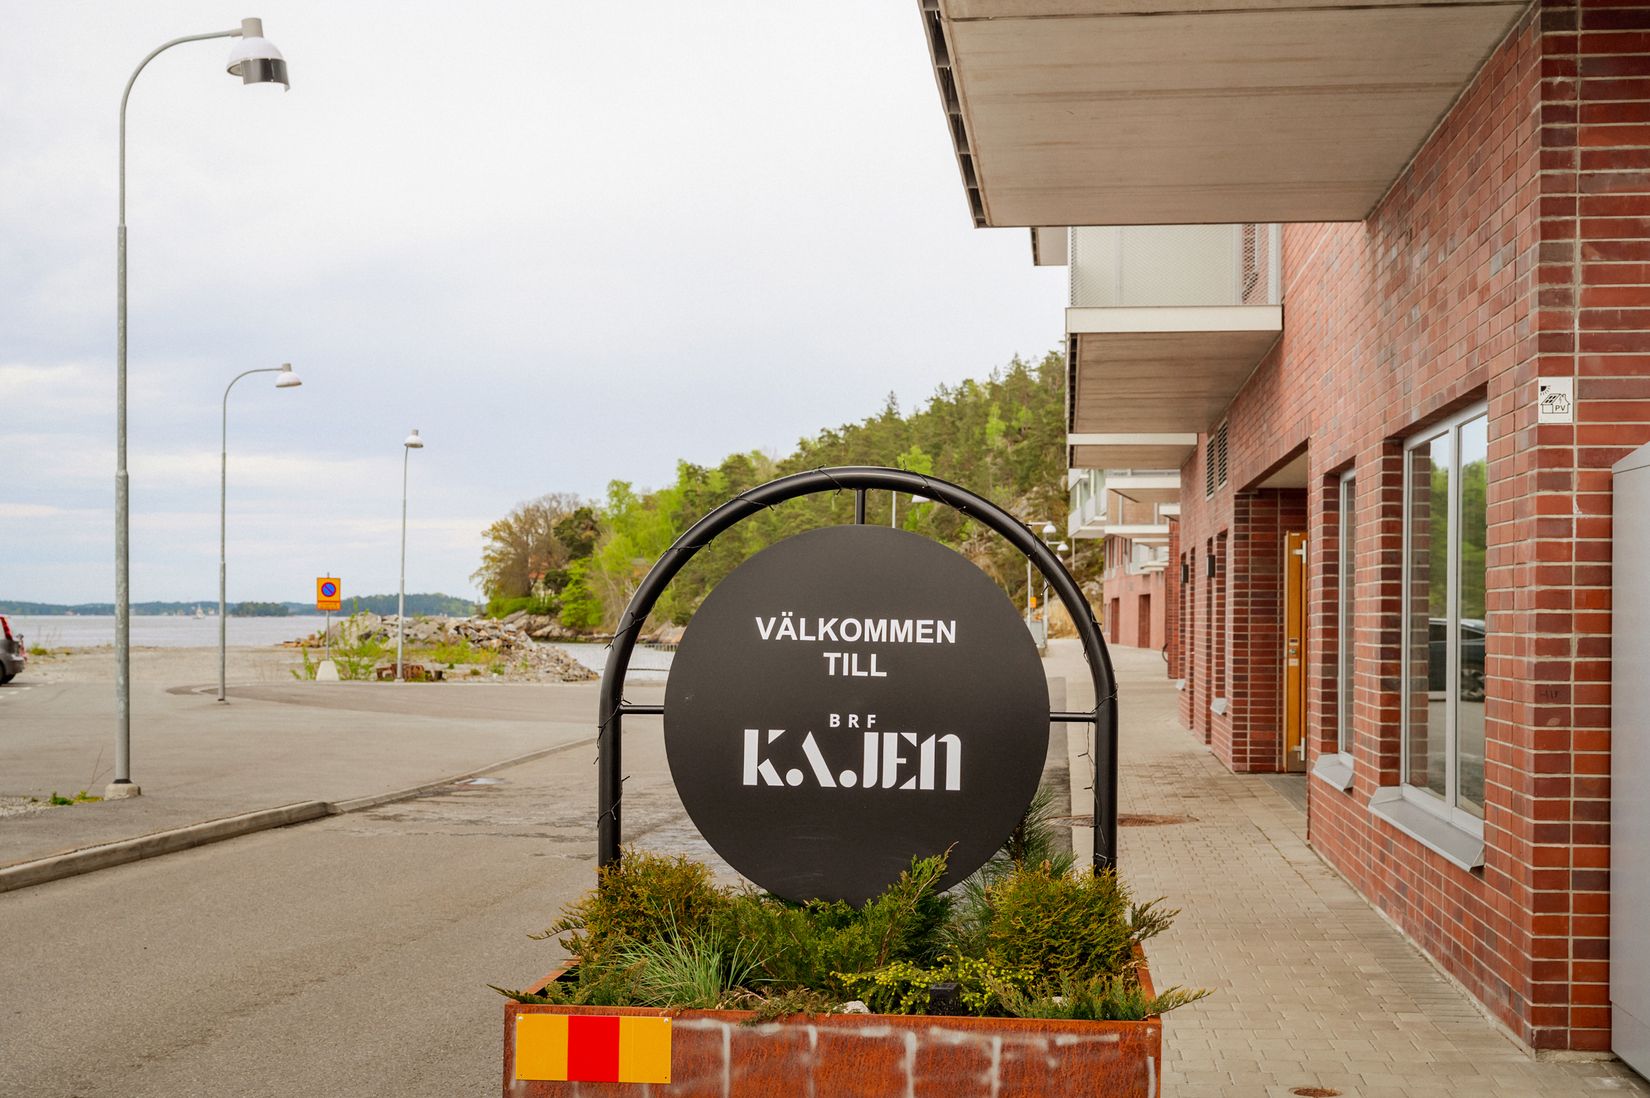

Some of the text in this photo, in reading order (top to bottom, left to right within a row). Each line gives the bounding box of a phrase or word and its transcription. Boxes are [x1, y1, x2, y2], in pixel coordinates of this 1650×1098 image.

[755, 611, 956, 644] VÄLKOMMEN
[823, 652, 887, 677] TILL
[829, 713, 877, 729] BRF
